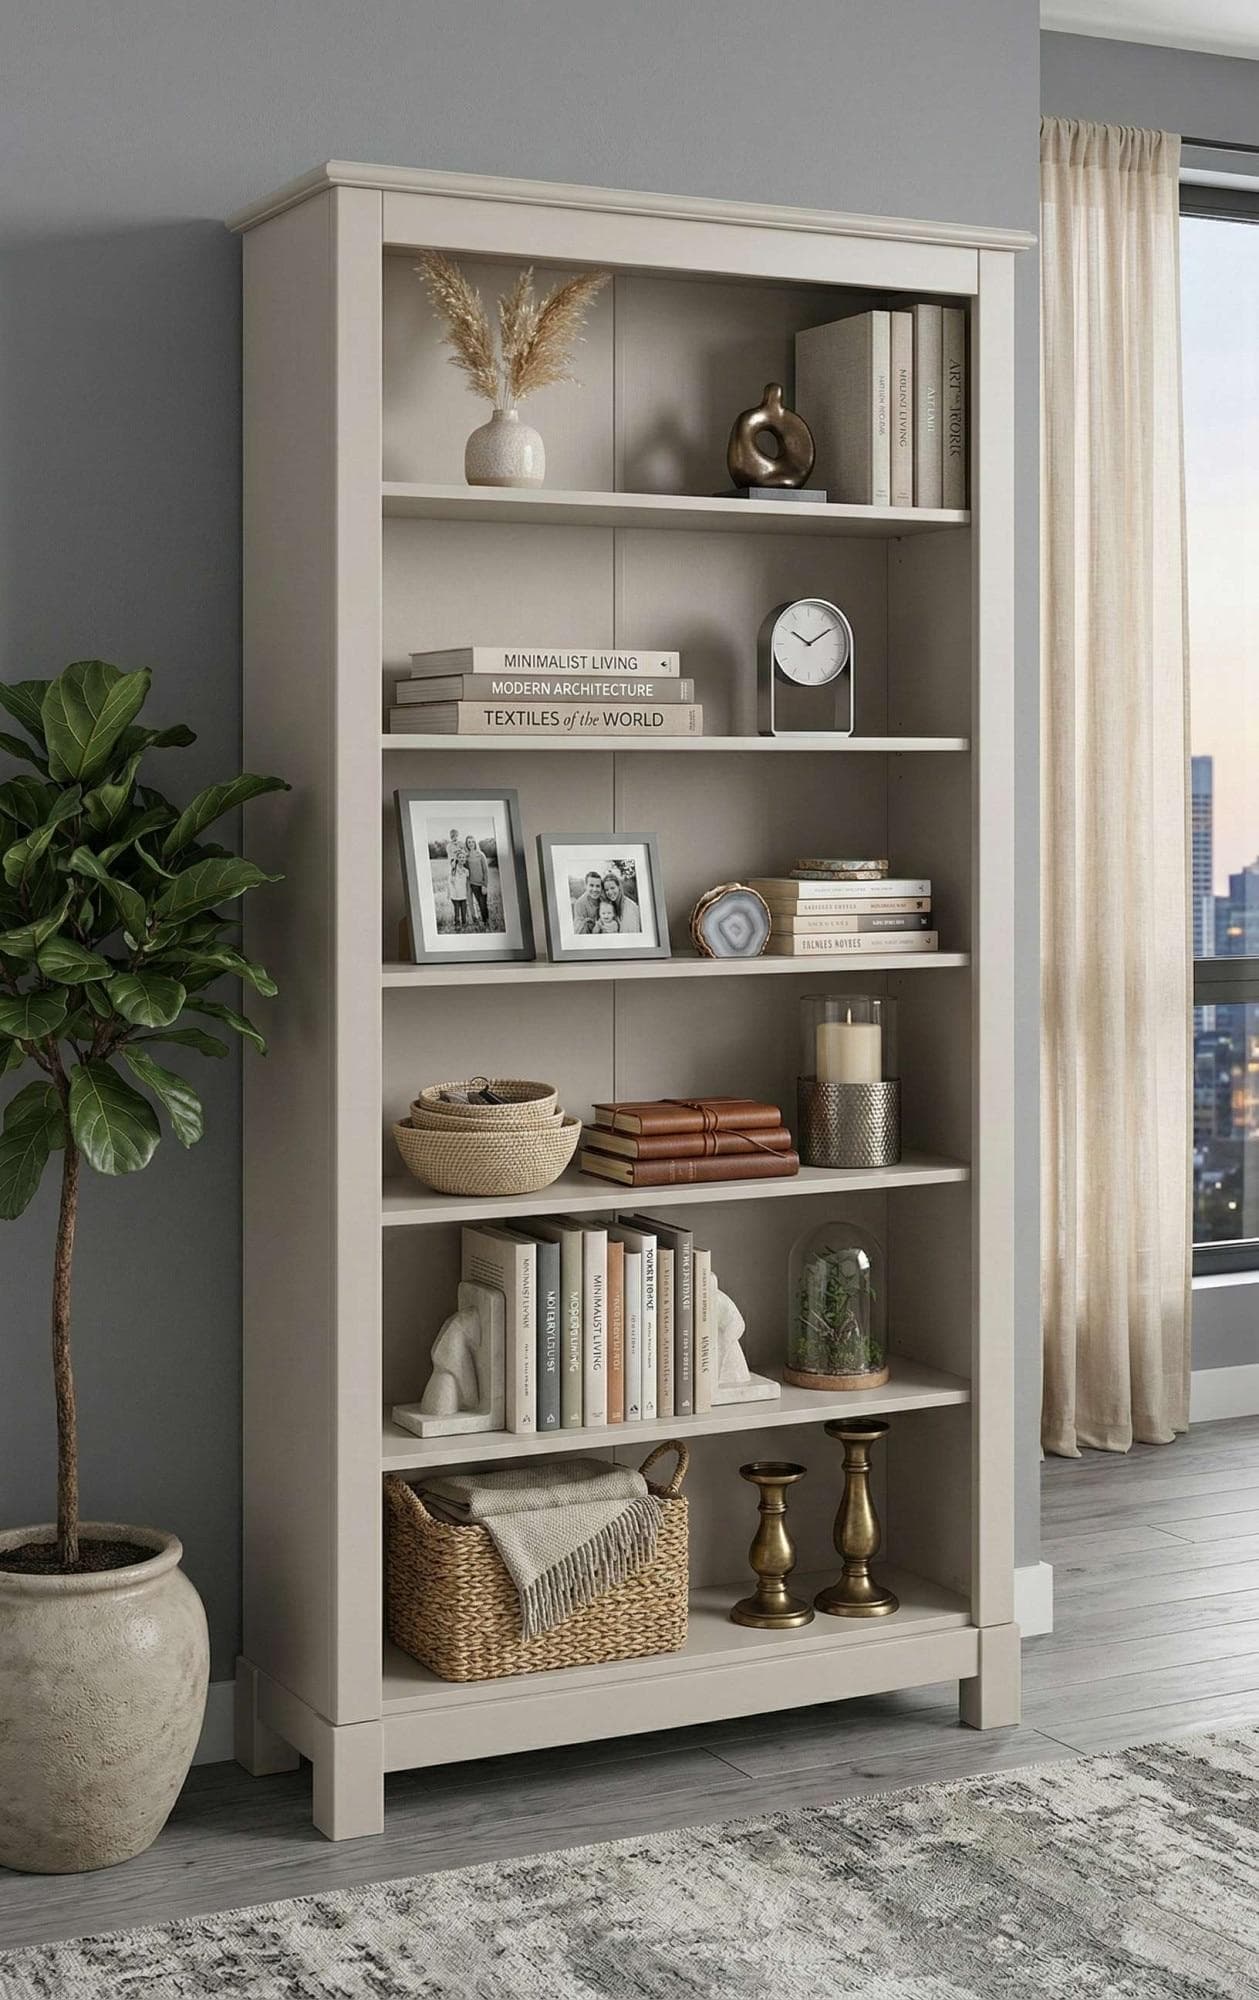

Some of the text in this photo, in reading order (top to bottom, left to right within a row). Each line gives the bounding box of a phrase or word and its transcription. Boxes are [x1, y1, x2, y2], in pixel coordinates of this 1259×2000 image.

[949, 359, 961, 392] ART
[899, 411, 908, 448] LIVING
[504, 654, 638, 671] MINIMALIST LIVING
[491, 681, 654, 697] MODERN ARCHITECTURE
[484, 710, 664, 731] TEXTILES of the WORLD
[593, 1335, 602, 1371] LIVING
